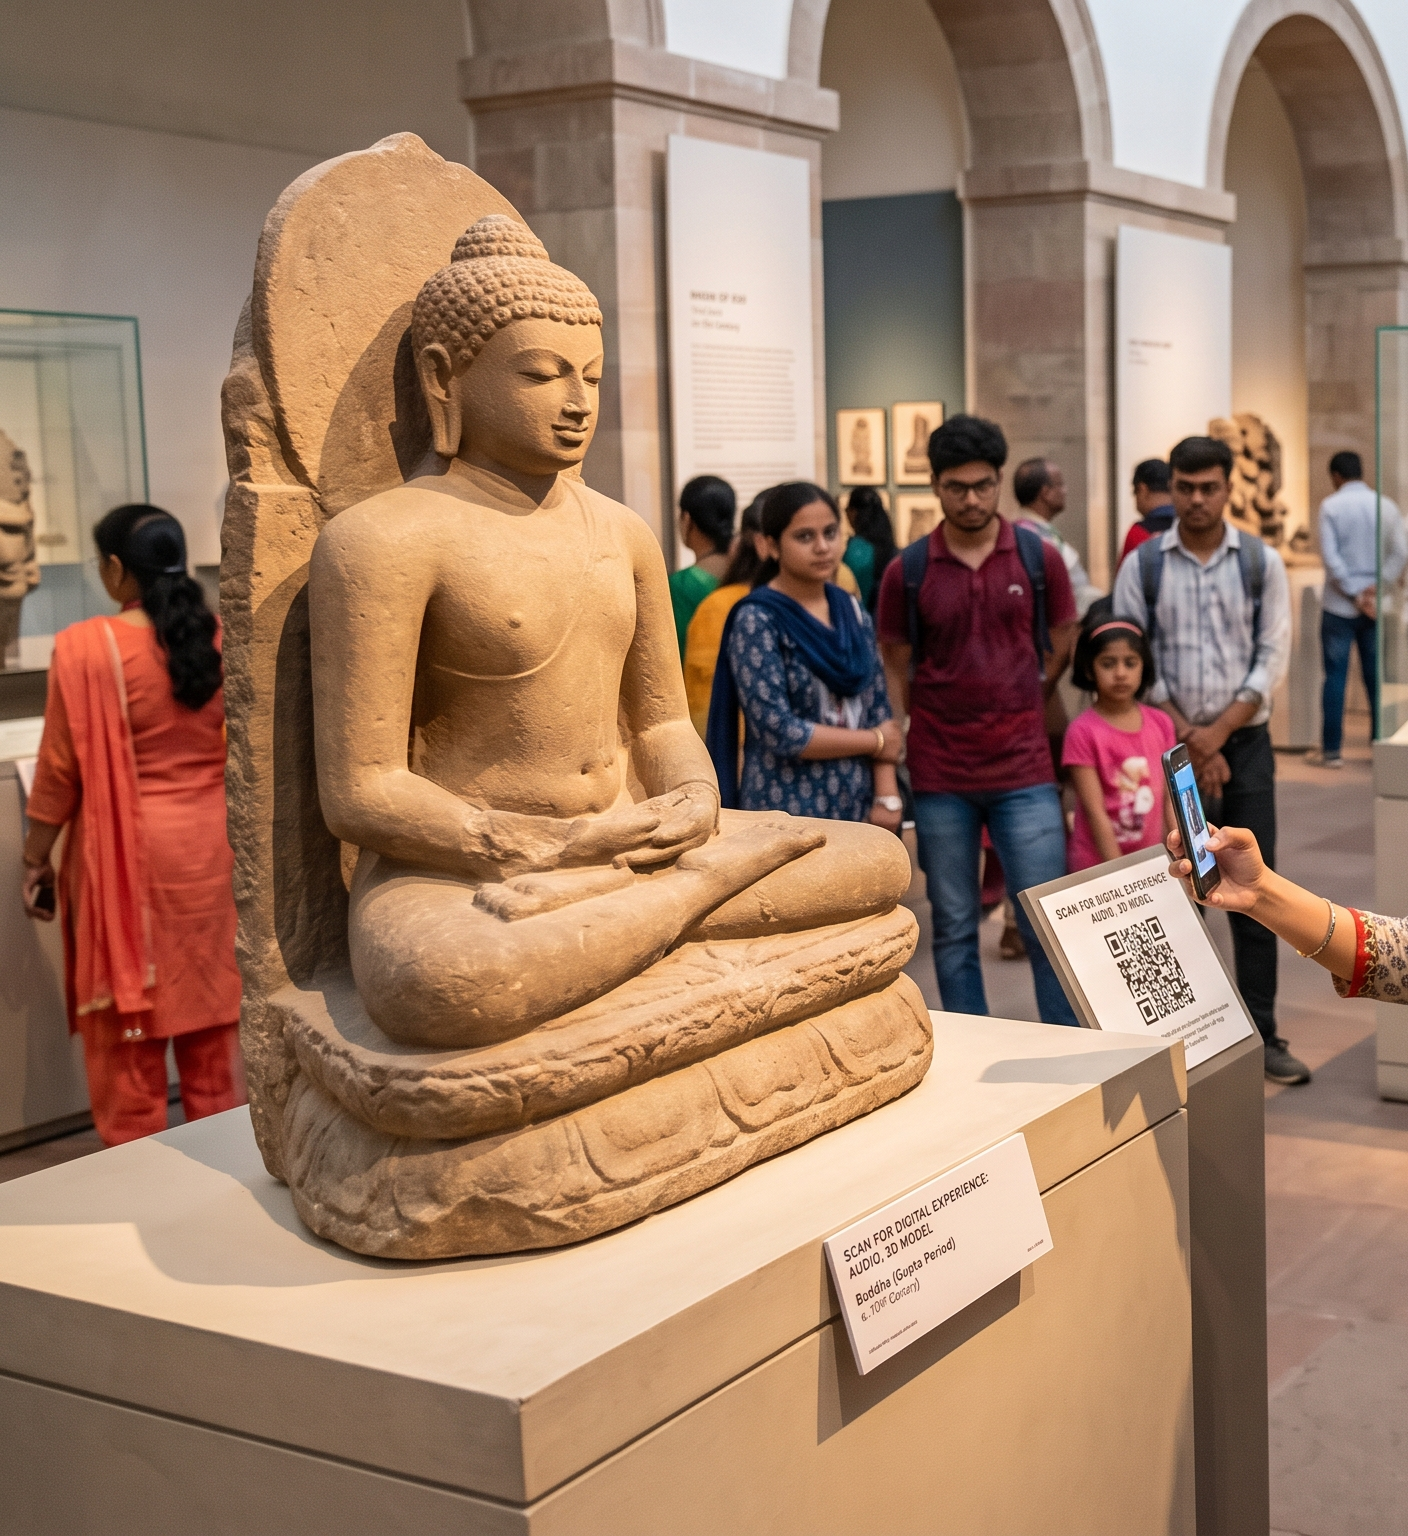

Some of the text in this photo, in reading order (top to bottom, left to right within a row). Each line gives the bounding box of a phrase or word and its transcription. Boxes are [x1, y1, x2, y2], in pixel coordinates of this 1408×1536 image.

[1055, 904, 1080, 920] SCAN
[1079, 897, 1096, 911] FOR
[843, 1237, 872, 1262] SCAN
[873, 1225, 894, 1246] FOR
[931, 1172, 989, 1213] EXPERIENCE:
[884, 1242, 899, 1258] 3D
[899, 1222, 934, 1250] MODEL
[892, 1259, 923, 1286] (Gupta
[923, 1236, 956, 1264] Period)
